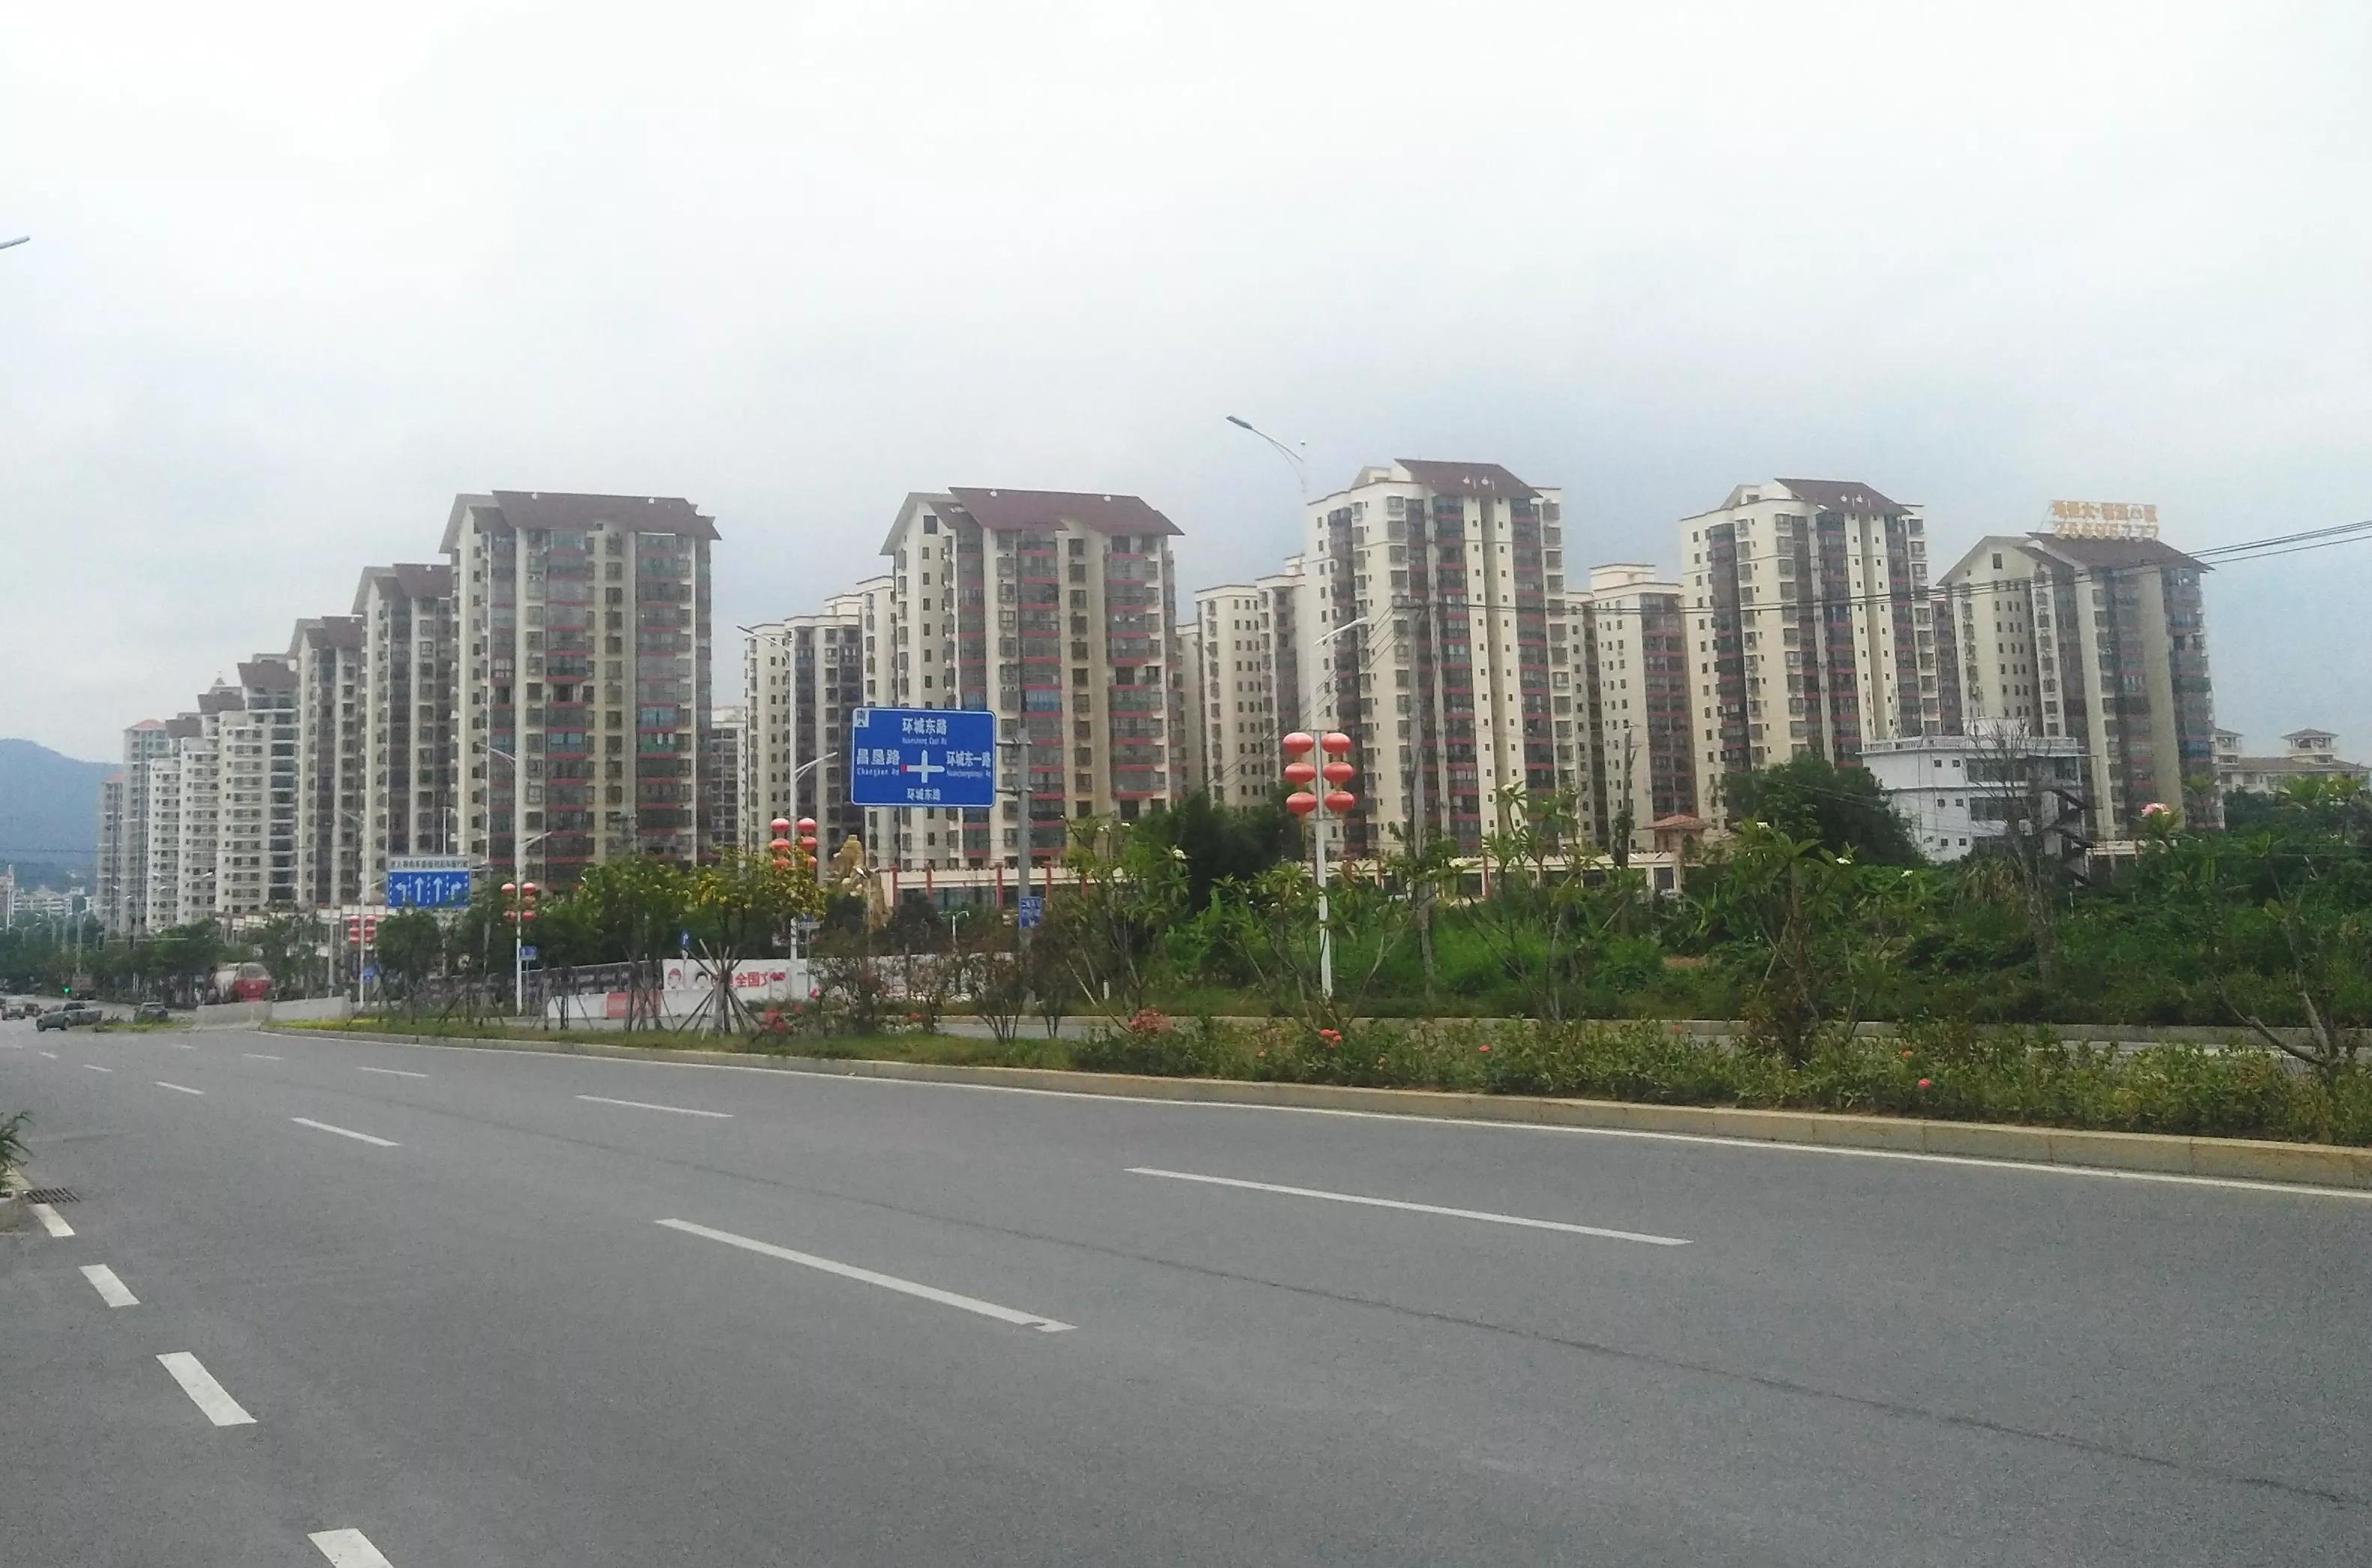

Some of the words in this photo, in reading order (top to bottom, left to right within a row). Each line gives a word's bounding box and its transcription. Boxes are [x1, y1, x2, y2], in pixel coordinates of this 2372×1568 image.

[901, 717, 947, 735] 环城东路
[946, 751, 991, 767] 环城东一路
[907, 788, 941, 801] 环城东路
